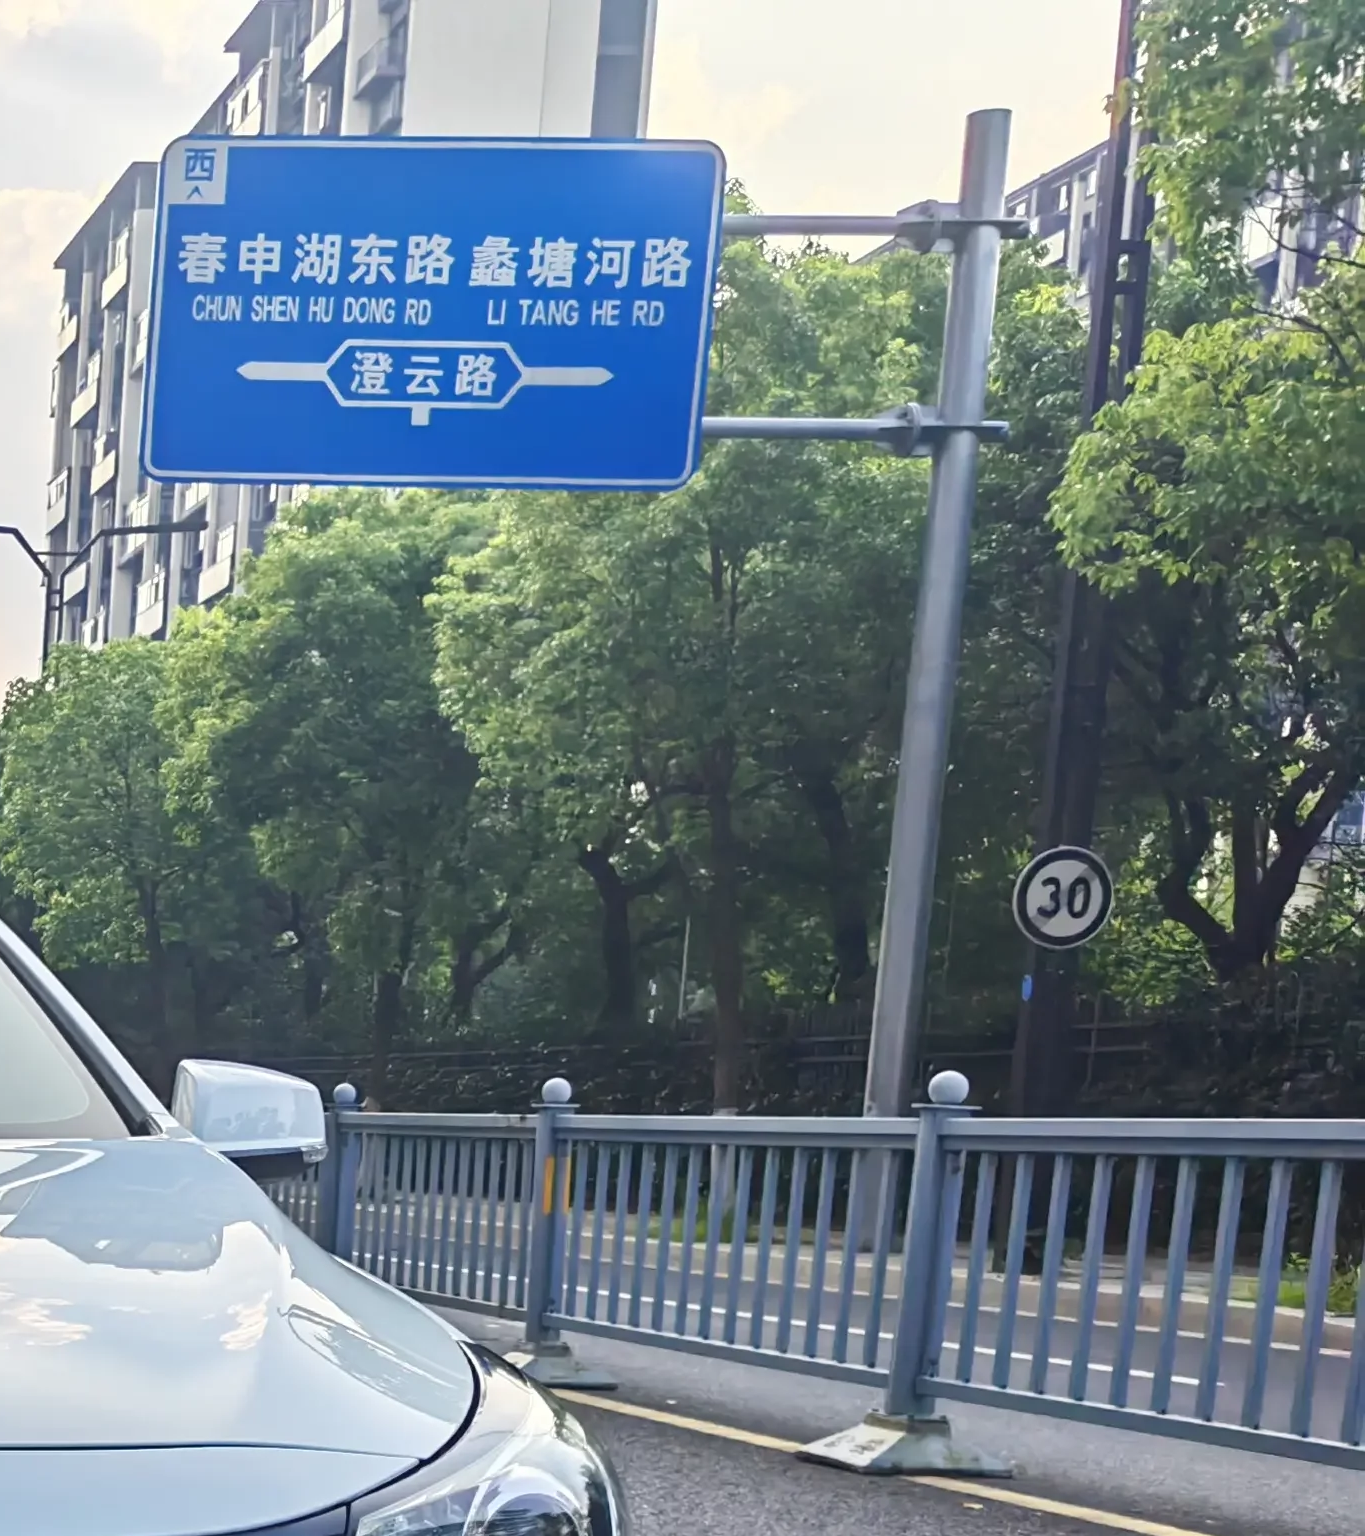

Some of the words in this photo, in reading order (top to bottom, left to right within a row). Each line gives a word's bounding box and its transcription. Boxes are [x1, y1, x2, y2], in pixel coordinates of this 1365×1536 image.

[185, 148, 217, 182] 西
[178, 233, 456, 285] 春申湖东路
[469, 235, 692, 288] 蠡塘河路
[192, 294, 242, 322] CHUN
[251, 295, 300, 322] SHEN
[308, 297, 334, 323] HU
[343, 297, 395, 324] DONG
[404, 299, 432, 326] RD
[487, 299, 507, 325] LI
[519, 300, 580, 326] TANG
[591, 300, 621, 326] HE
[632, 301, 665, 327] RD
[351, 350, 497, 396] 澄云路
[1037, 877, 1091, 919] 30
